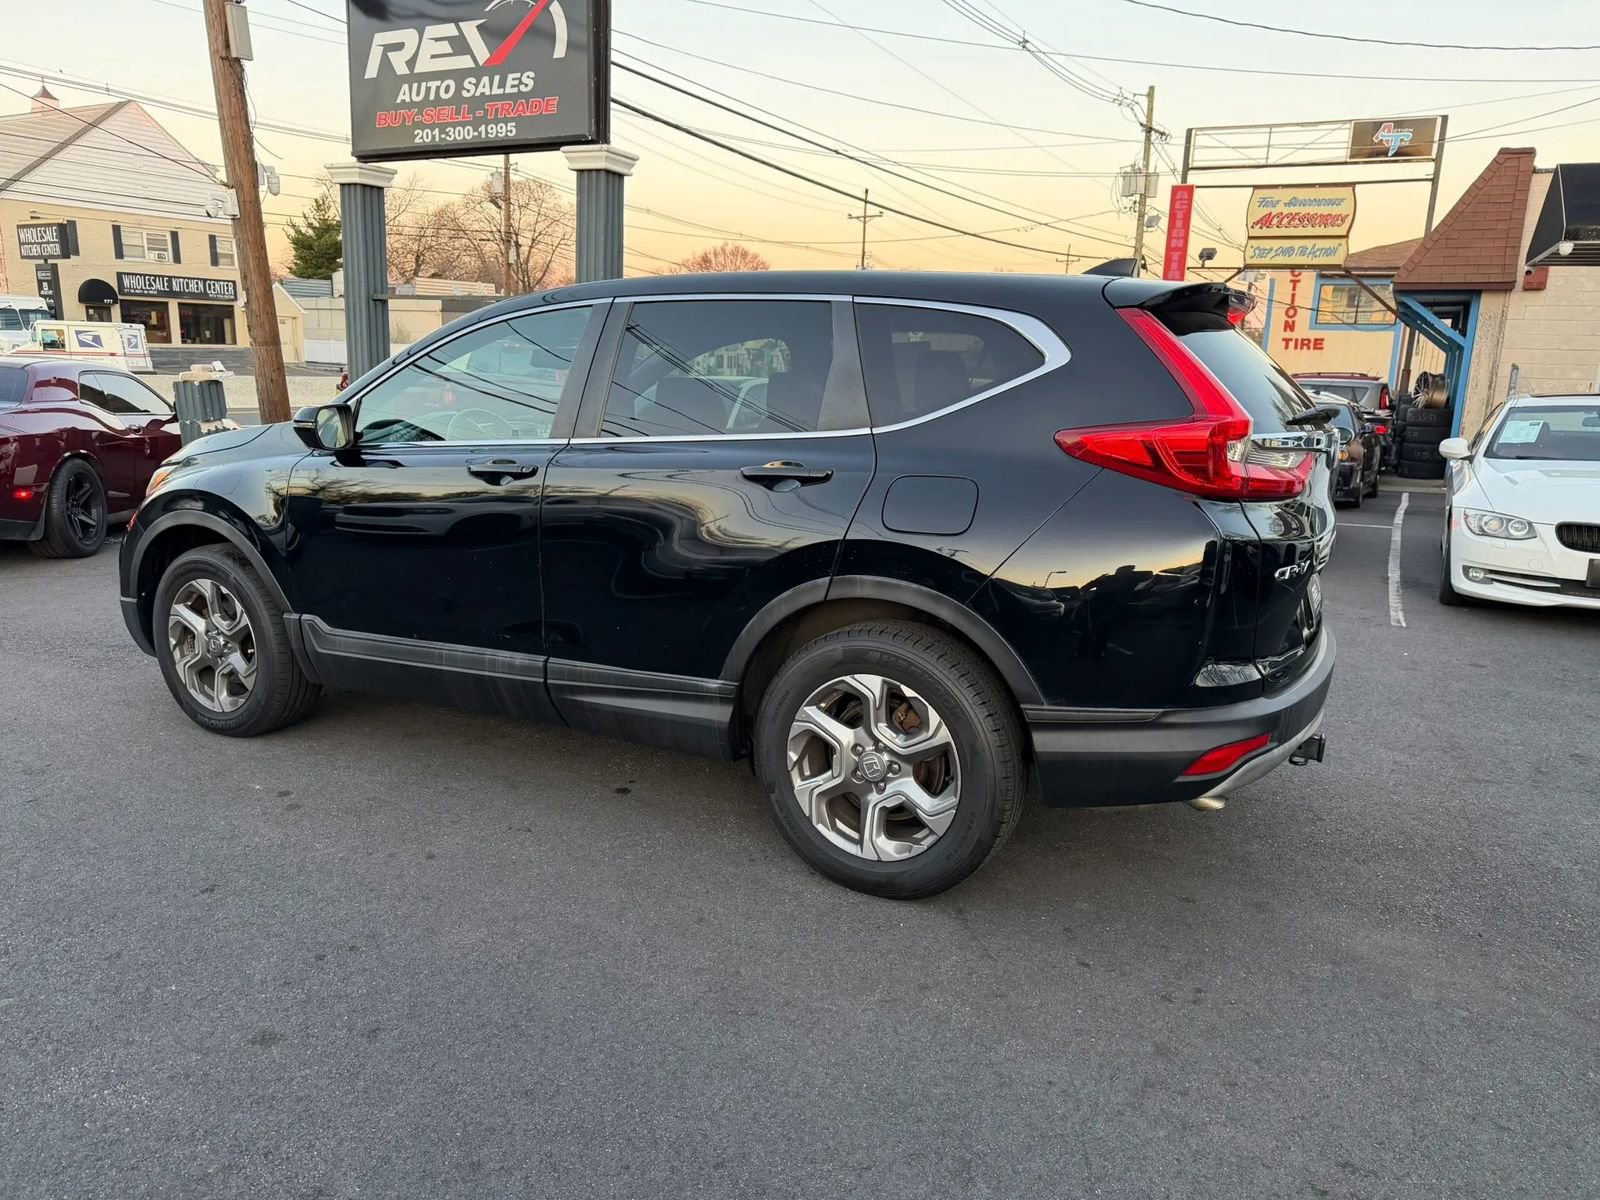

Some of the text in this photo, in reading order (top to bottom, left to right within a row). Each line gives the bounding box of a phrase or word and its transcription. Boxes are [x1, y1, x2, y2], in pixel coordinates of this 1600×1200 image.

[396, 71, 535, 104] AUTO SALES
[485, 96, 559, 119] TRADE
[414, 122, 516, 143] 201-300-1995
[1170, 190, 1188, 248] ACTION
[1250, 211, 1349, 229] ACCESSORIES
[18, 226, 58, 242] WHOLESALE
[21, 243, 60, 256] KITCHEN CENTER
[122, 274, 234, 295] WHOLESALE KITCHEN CENTER
[1282, 338, 1325, 350] TIRE
